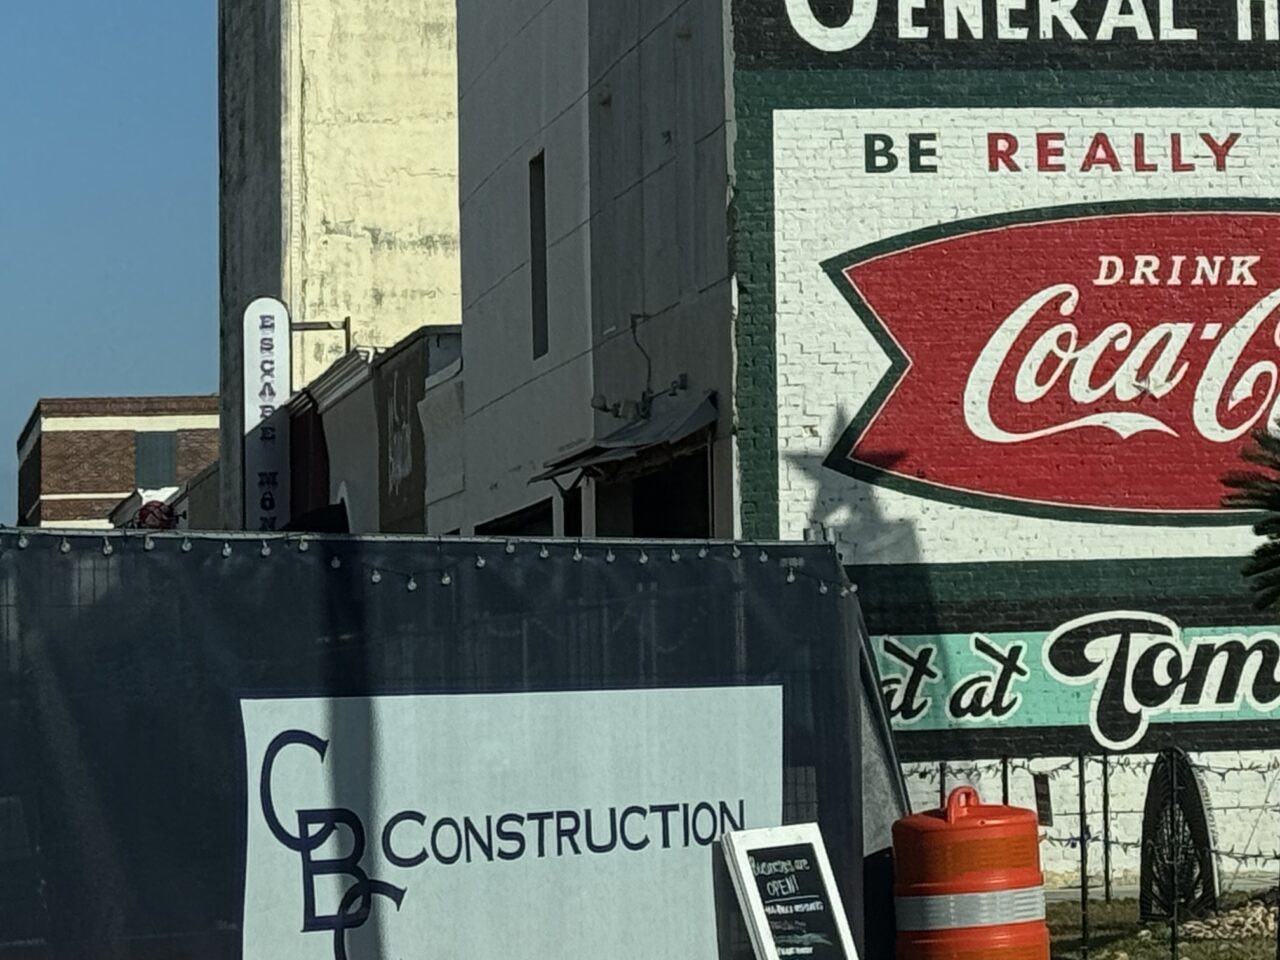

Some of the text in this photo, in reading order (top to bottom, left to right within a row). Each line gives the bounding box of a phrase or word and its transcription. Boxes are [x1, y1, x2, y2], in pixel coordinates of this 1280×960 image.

[864, 132, 938, 174] BE
[987, 132, 1241, 172] REALLY
[1093, 255, 1261, 287] DRINK
[258, 315, 277, 440] ESCAPE
[949, 636, 1028, 719] at
[382, 800, 745, 868] CONSTRUCTION
